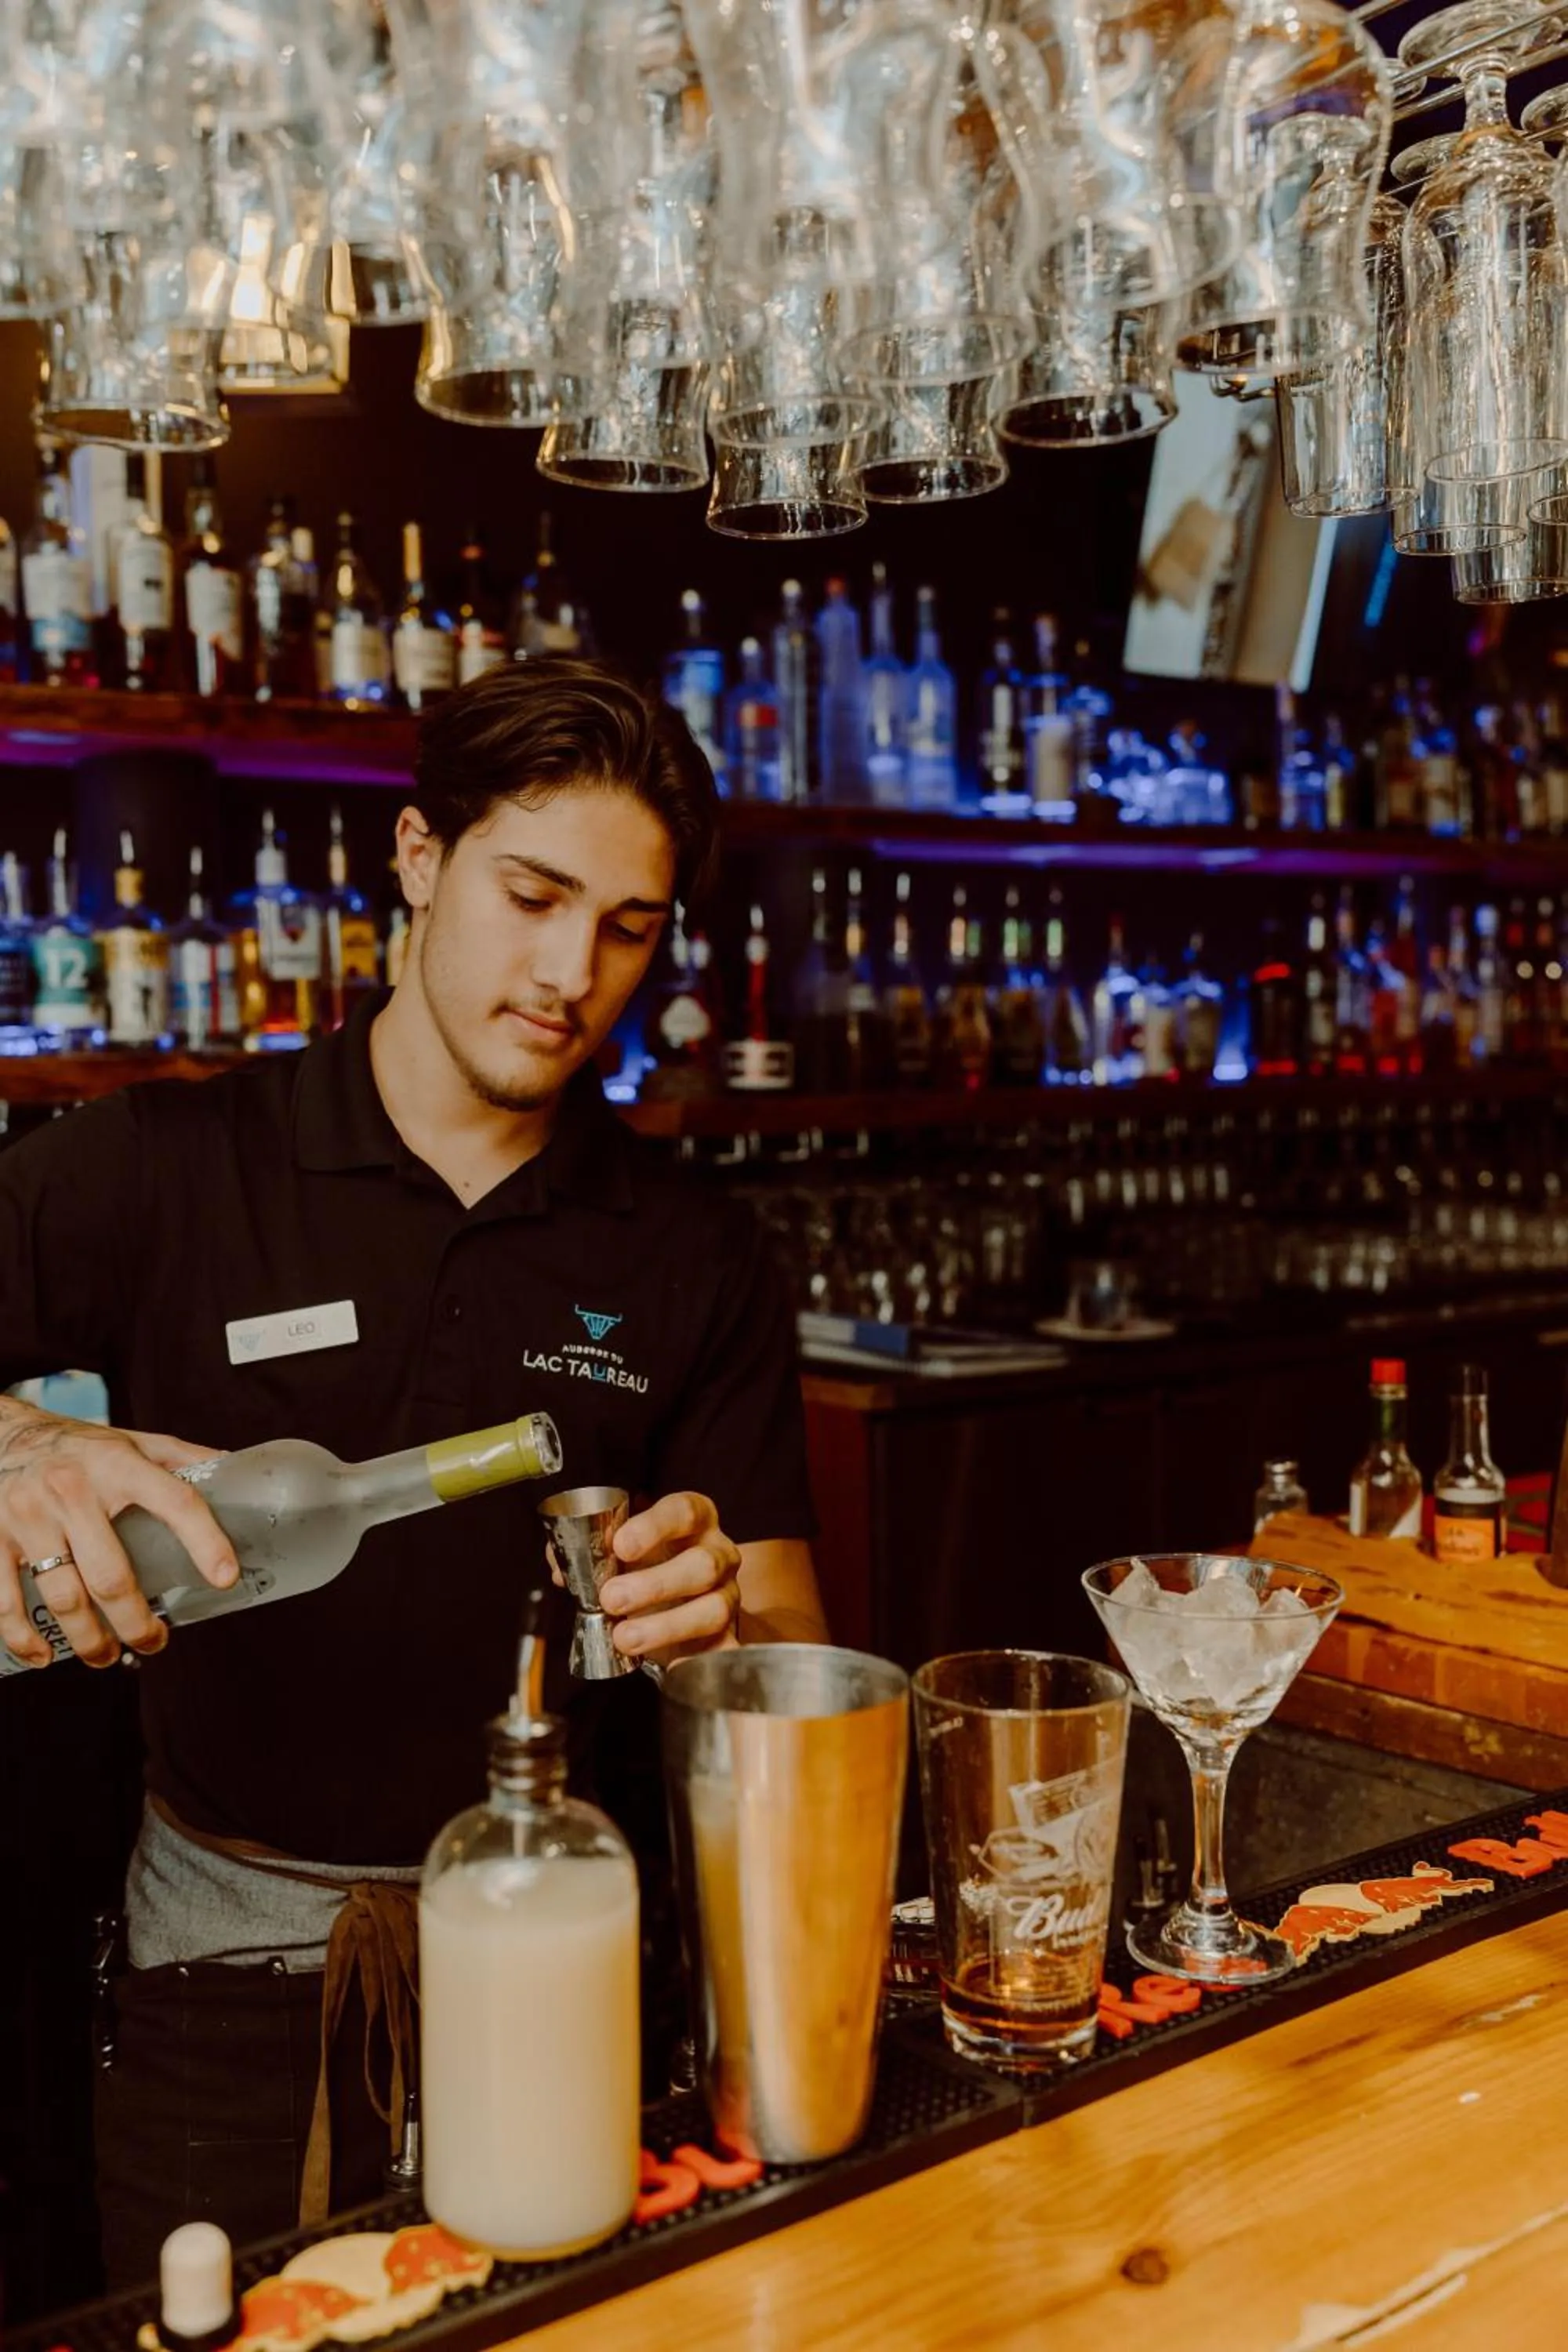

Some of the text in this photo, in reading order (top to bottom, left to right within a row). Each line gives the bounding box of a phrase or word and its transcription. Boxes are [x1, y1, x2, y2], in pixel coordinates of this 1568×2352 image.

[287, 1320, 315, 1338] LEO
[523, 1348, 649, 1393] LAC TAUREAU
[610, 1352, 624, 1365] DU
[31, 1604, 74, 1655] GRE
